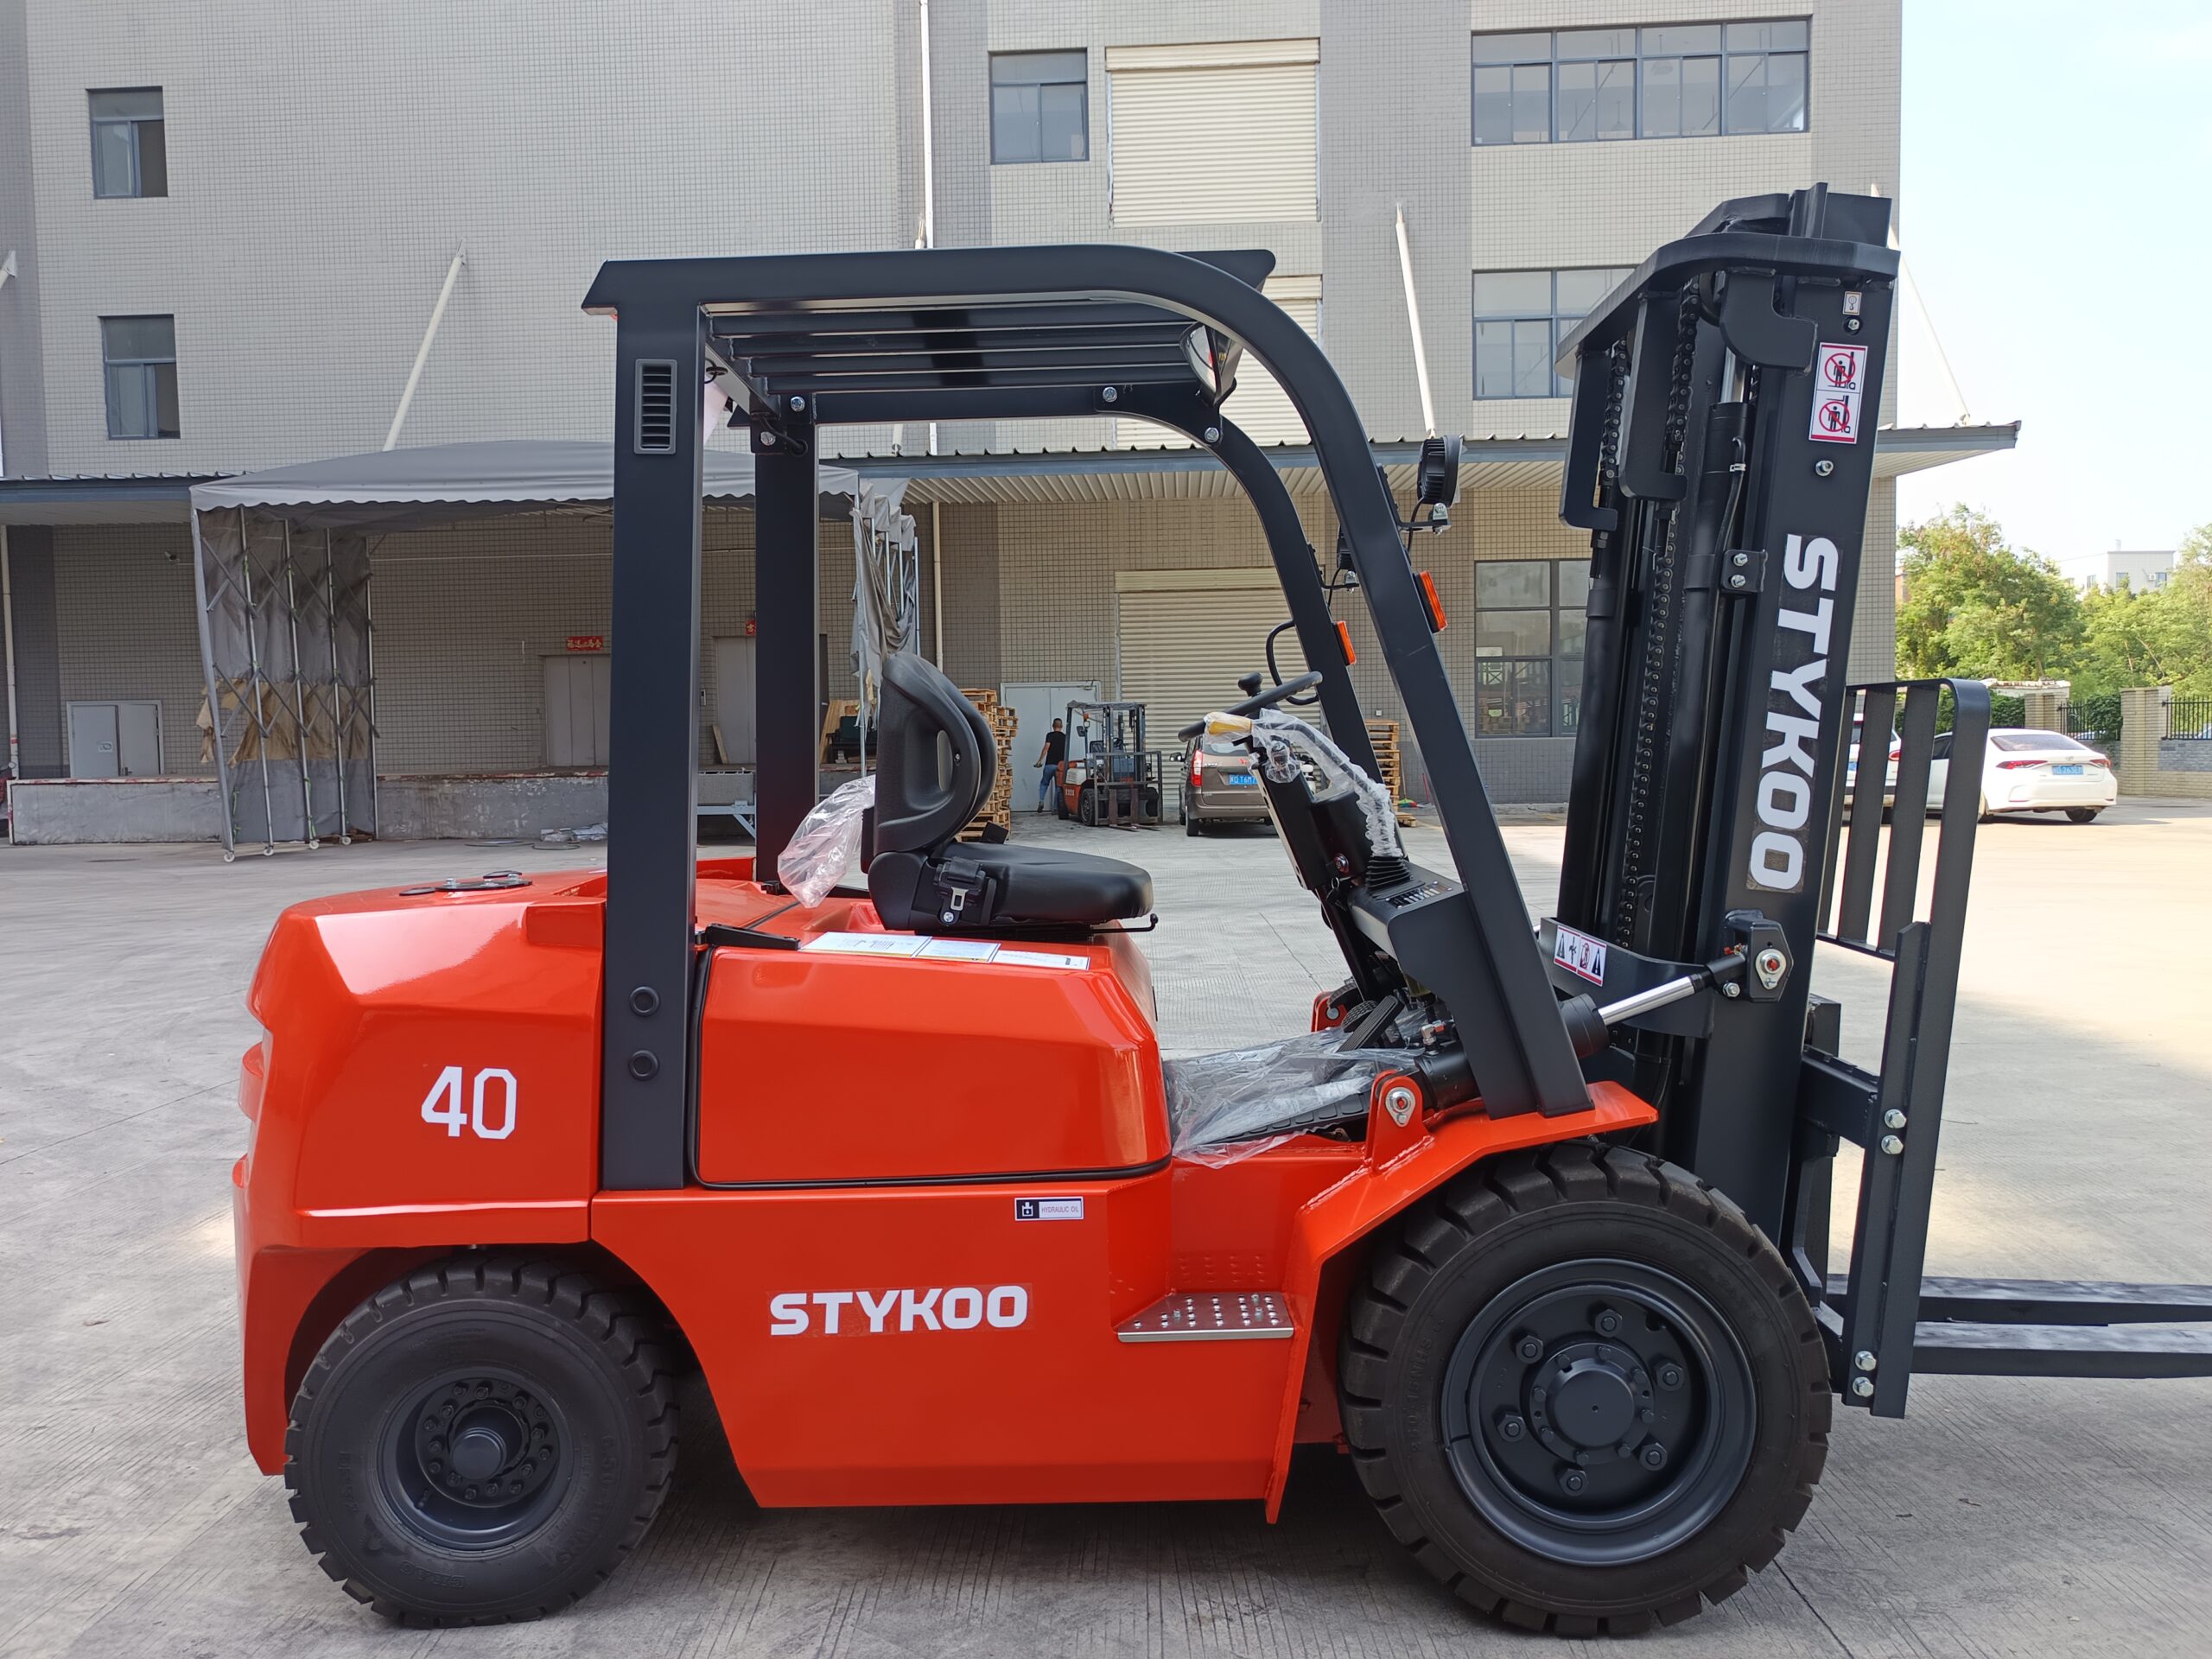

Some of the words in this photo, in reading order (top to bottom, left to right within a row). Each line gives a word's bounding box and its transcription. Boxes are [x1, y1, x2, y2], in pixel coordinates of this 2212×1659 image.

[1750, 534, 1840, 890] STYKOO
[421, 1065, 518, 1140] 40
[770, 1284, 1029, 1337] STYKOO
